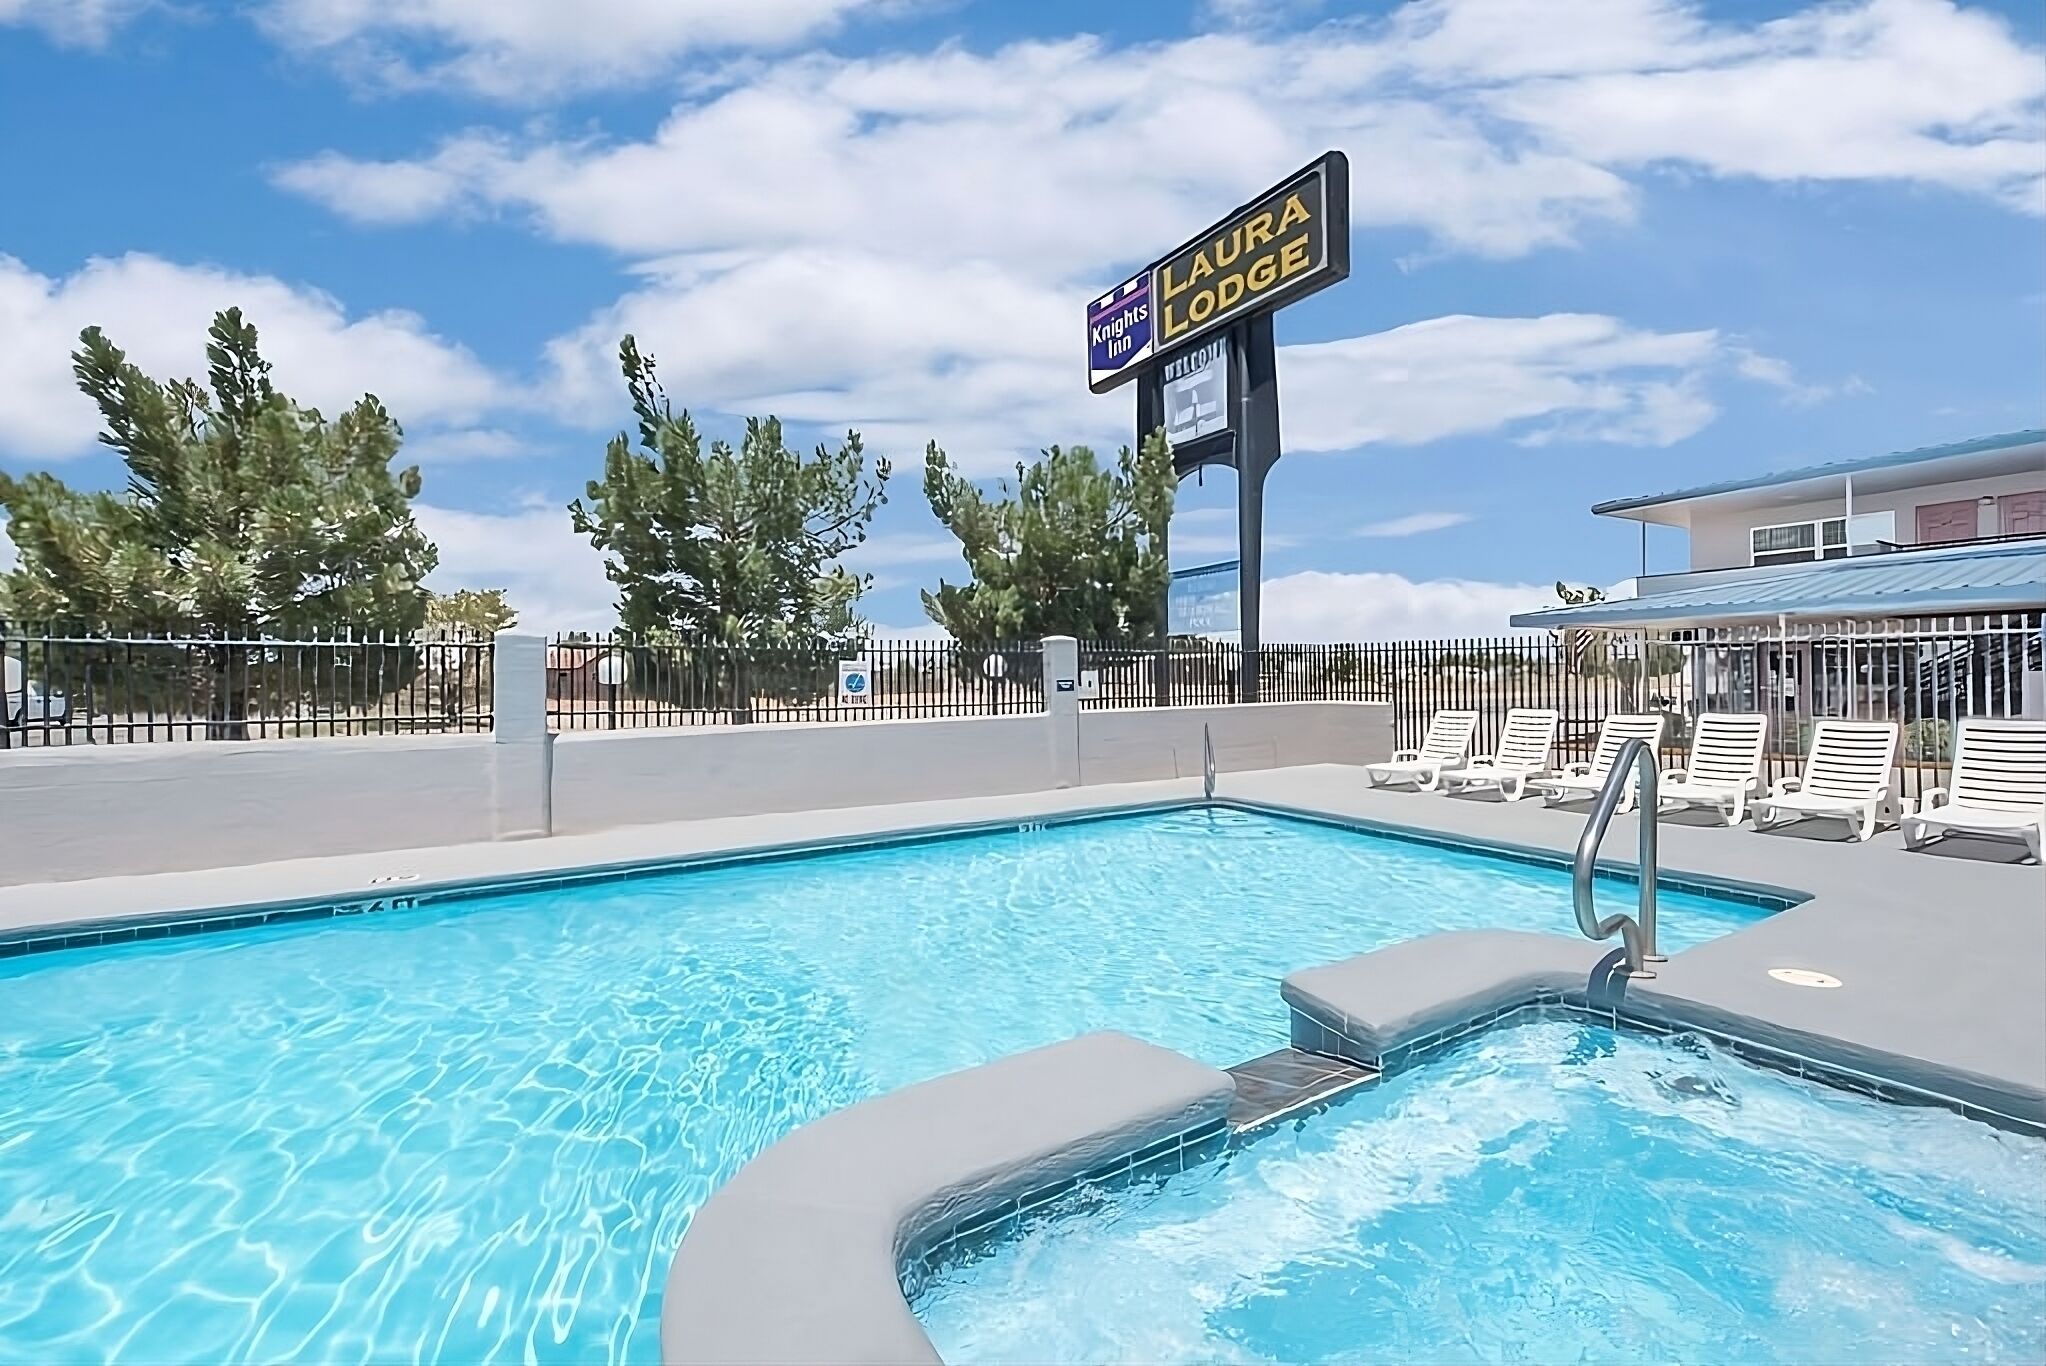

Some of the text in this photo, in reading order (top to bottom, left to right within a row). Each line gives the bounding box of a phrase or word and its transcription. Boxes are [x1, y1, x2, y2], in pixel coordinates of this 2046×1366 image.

[1163, 193, 1311, 300] LAURA
[1164, 232, 1309, 339] LODGE
[1092, 303, 1148, 347] Knights
[1108, 334, 1132, 359] Inn
